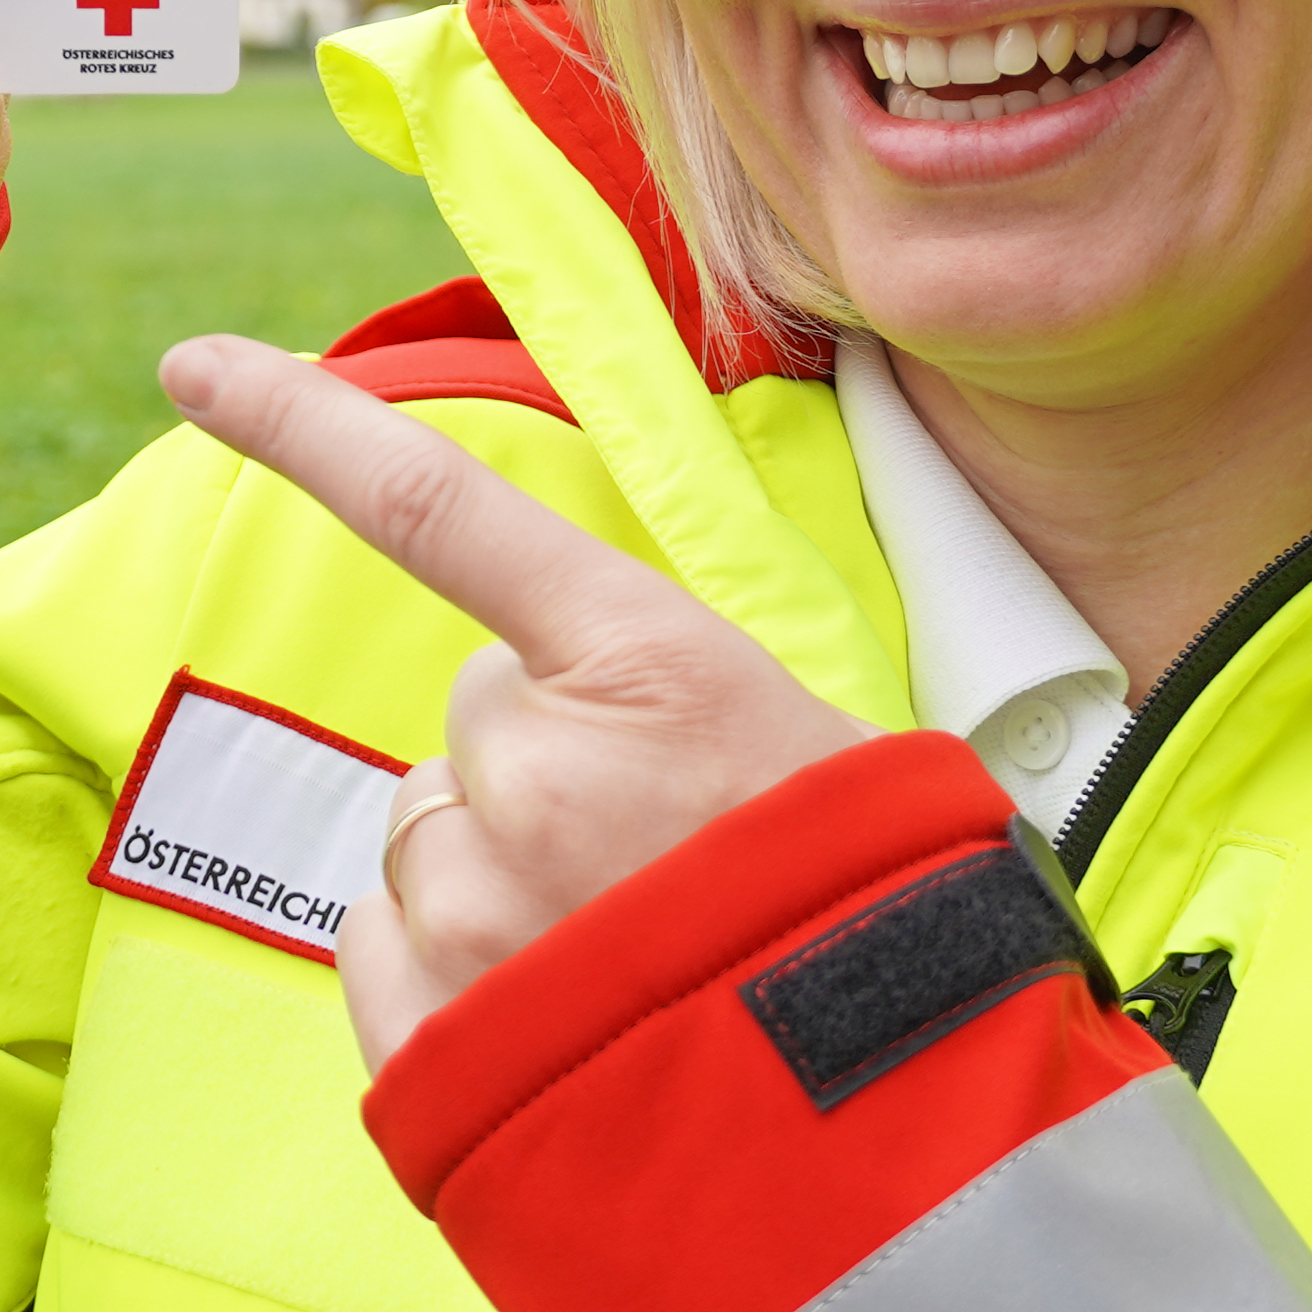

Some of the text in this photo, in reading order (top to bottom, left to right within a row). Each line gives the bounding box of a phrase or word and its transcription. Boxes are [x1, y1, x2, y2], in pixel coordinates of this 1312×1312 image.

[62, 48, 176, 60] ÖSTERREICHISCHES
[79, 63, 158, 74] ROTES KREUZ
